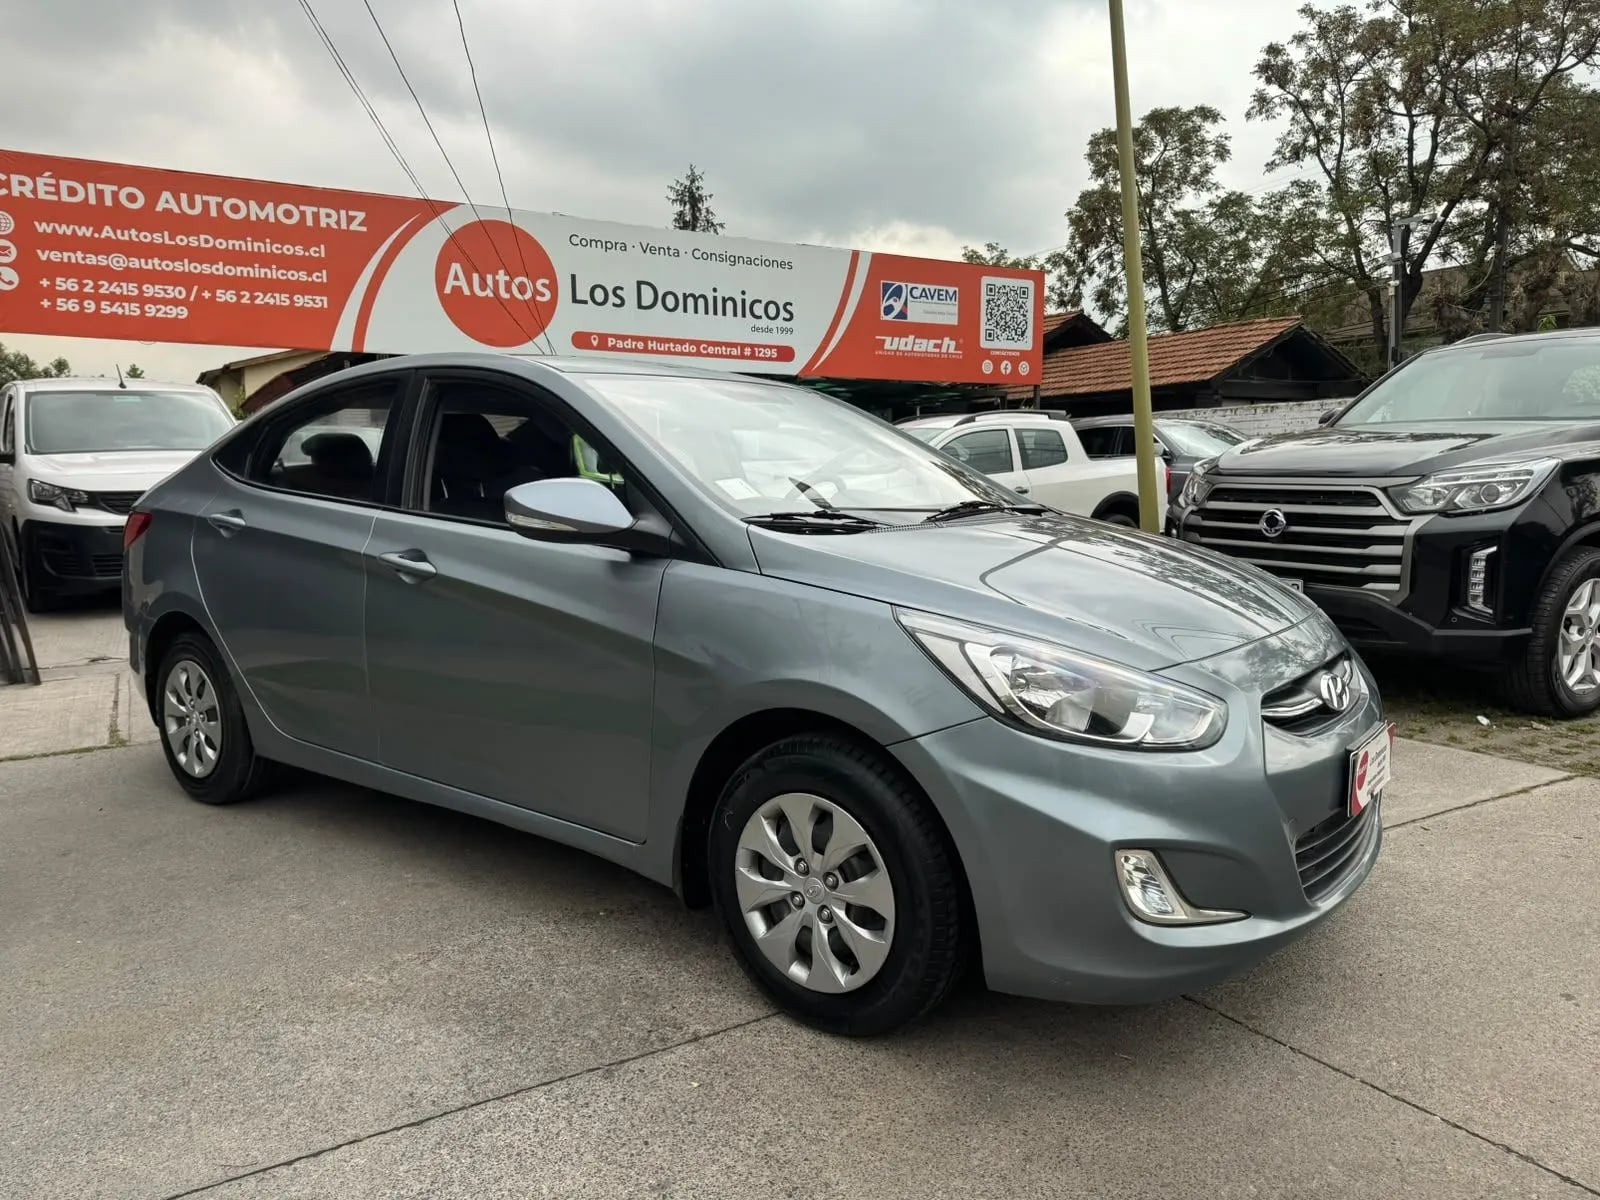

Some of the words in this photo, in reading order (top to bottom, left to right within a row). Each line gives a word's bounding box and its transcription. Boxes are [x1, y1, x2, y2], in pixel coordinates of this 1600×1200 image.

[155, 191, 367, 232] AUTOMOTRIZ
[34, 220, 326, 258] www.AutosLosDominicos.cl
[568, 233, 628, 253] Compra
[639, 241, 680, 258] Venta
[691, 248, 793, 270] Consignaciones
[36, 248, 328, 283] ventas@autoslosdominicos.cl
[443, 262, 552, 302] Autos
[55, 277, 79, 292] 56
[82, 279, 95, 293] 2
[98, 280, 139, 296] 2415
[142, 284, 187, 300] 9530
[215, 289, 237, 303] 56
[240, 291, 251, 304] 2
[254, 291, 290, 306] 2415
[293, 294, 328, 309] 9531
[56, 297, 80, 313] 56
[83, 299, 96, 314] 9
[100, 301, 141, 317] 5415
[144, 304, 188, 320] 9299
[570, 273, 626, 309] Los
[636, 280, 794, 322] Dominicos
[909, 286, 957, 302] CAVEM
[750, 324, 774, 334] desde
[775, 326, 794, 335] 1999
[875, 335, 963, 354] udach
[607, 336, 644, 350] Padre
[647, 340, 697, 353] Hurtado
[700, 344, 741, 356] Central
[743, 347, 752, 357] #
[754, 347, 778, 358] 1295
